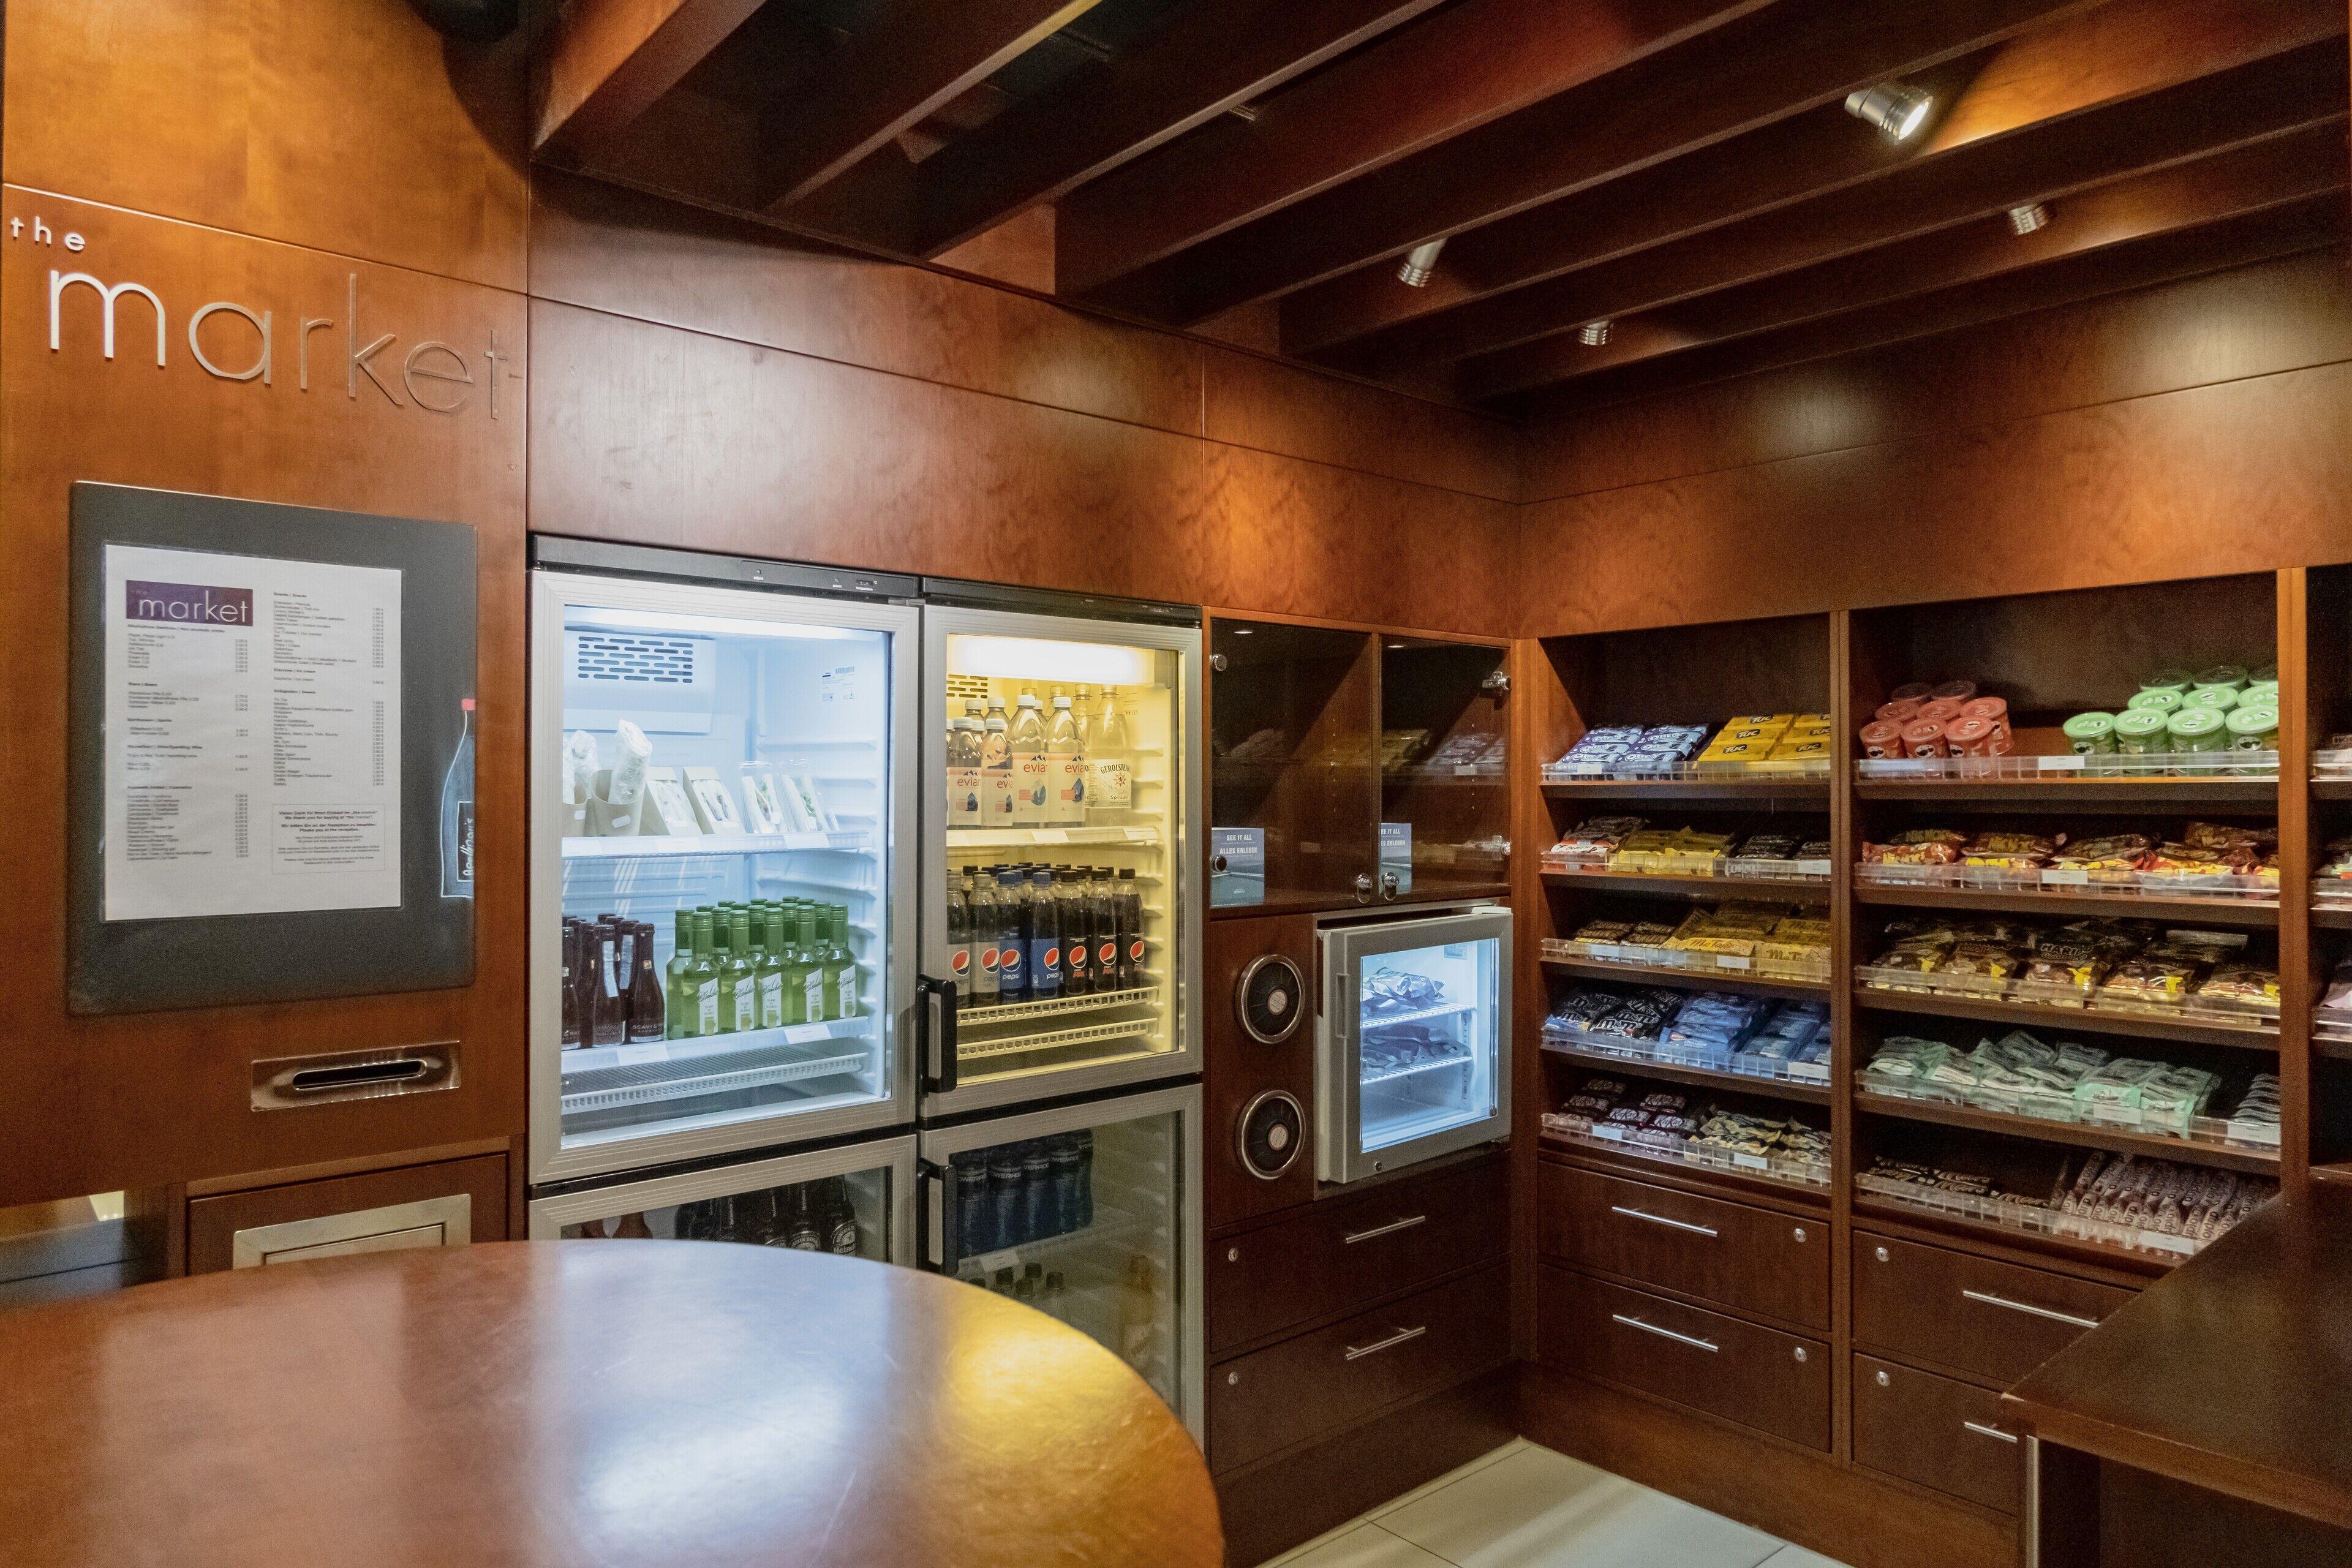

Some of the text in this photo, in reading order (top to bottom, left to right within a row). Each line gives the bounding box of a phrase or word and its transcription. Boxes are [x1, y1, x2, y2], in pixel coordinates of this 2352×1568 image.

[11, 216, 85, 251] the
[50, 271, 508, 420] market
[140, 590, 248, 622] market
[1065, 763, 1084, 773] evia
[1656, 1117, 1682, 1128] KitKat
